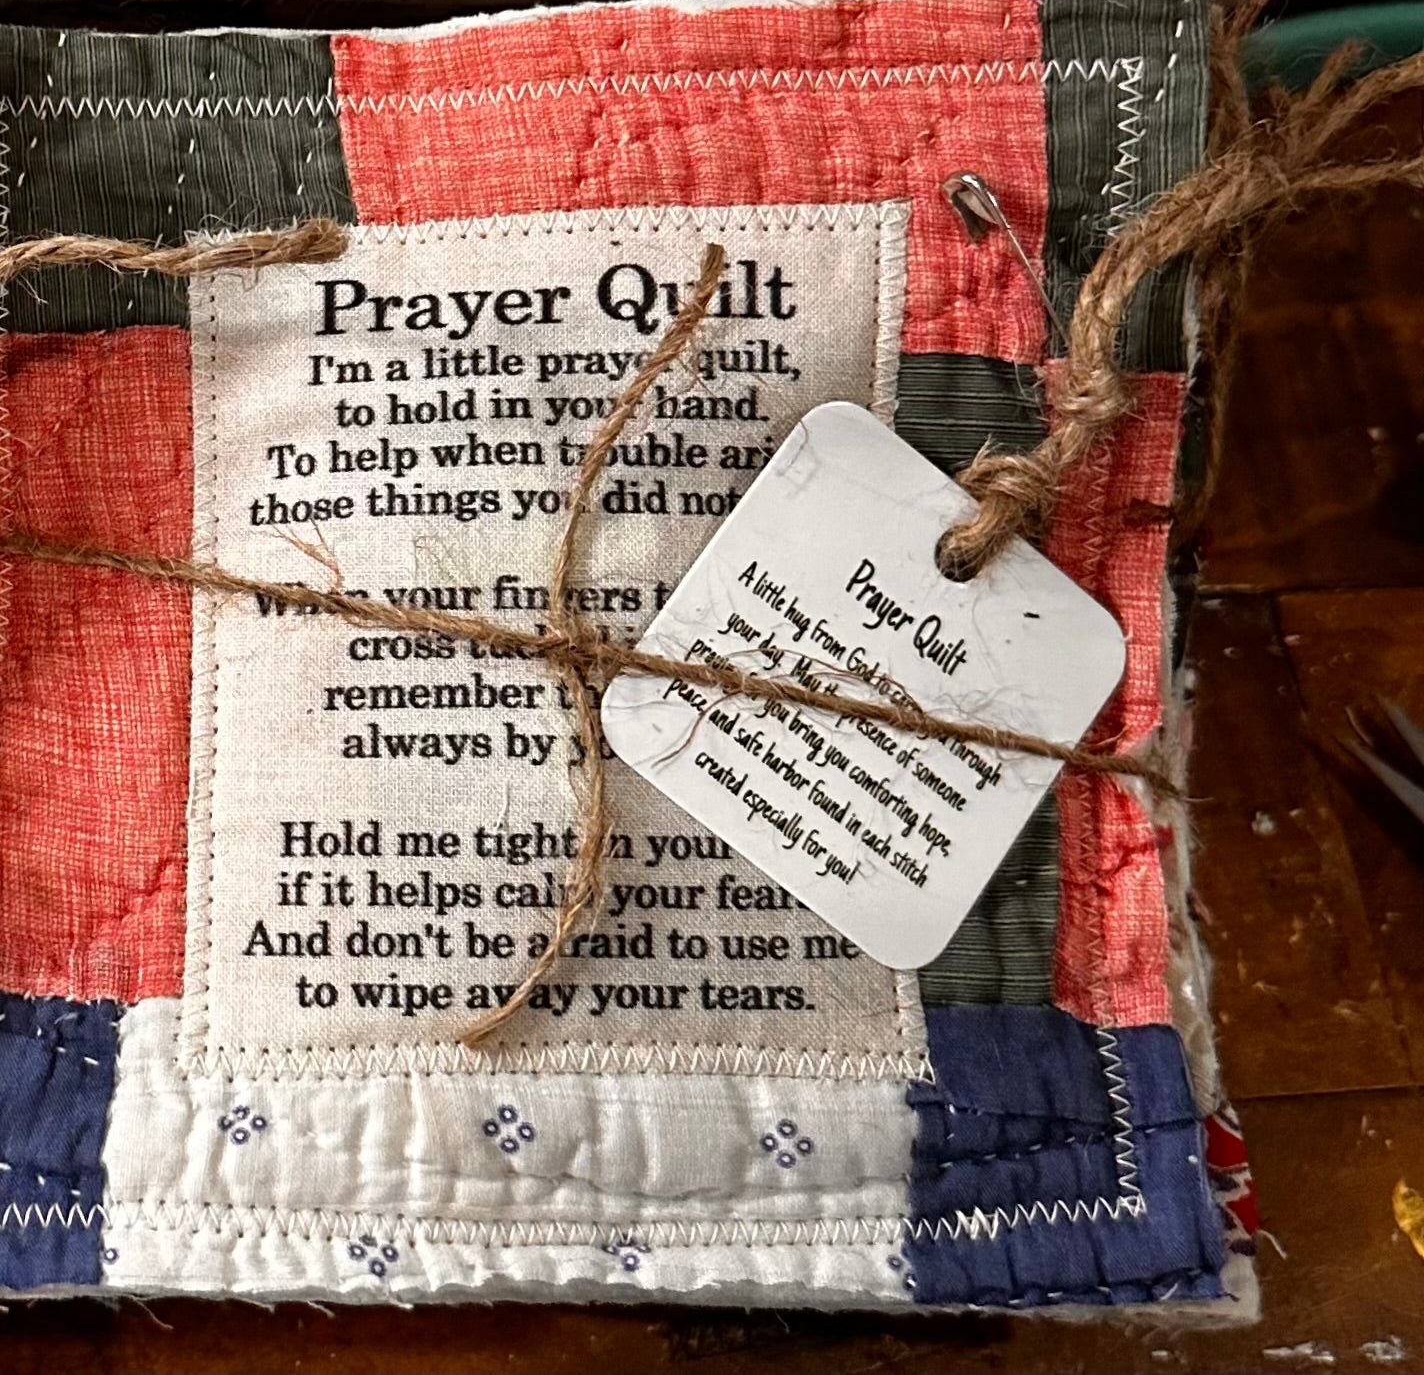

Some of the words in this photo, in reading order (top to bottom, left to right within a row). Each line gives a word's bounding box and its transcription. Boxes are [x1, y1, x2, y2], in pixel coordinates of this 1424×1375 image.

[313, 278, 572, 341] Prayer
[307, 354, 375, 387] I'm
[385, 359, 411, 382] a
[421, 344, 526, 380] little
[692, 336, 802, 388] quilt,
[248, 493, 355, 530] those
[366, 482, 503, 523] things
[598, 483, 671, 516] did
[737, 560, 758, 588] A
[752, 570, 787, 612] little
[783, 596, 812, 643] hug
[809, 618, 847, 662] from
[842, 646, 881, 687] God
[845, 558, 916, 632] Prayer
[912, 614, 967, 677] Quilt
[694, 751, 749, 797] created
[742, 789, 805, 851] especially
[801, 828, 828, 860] for
[815, 853, 862, 886] you!
[708, 701, 740, 736] and
[733, 727, 765, 757] safe
[761, 741, 811, 791] harbor
[807, 778, 852, 824] found
[844, 812, 863, 837] in
[860, 828, 893, 860] each
[889, 851, 929, 889] stitch
[279, 818, 383, 859] Hold
[394, 831, 461, 859] me
[241, 919, 333, 959] And
[344, 920, 455, 960] don't
[463, 920, 516, 960] be
[666, 927, 710, 961] to
[718, 934, 792, 962] use
[295, 974, 339, 1009] to
[350, 971, 455, 1019] wipe
[588, 983, 690, 1018] your
[697, 977, 816, 1012] tears.
